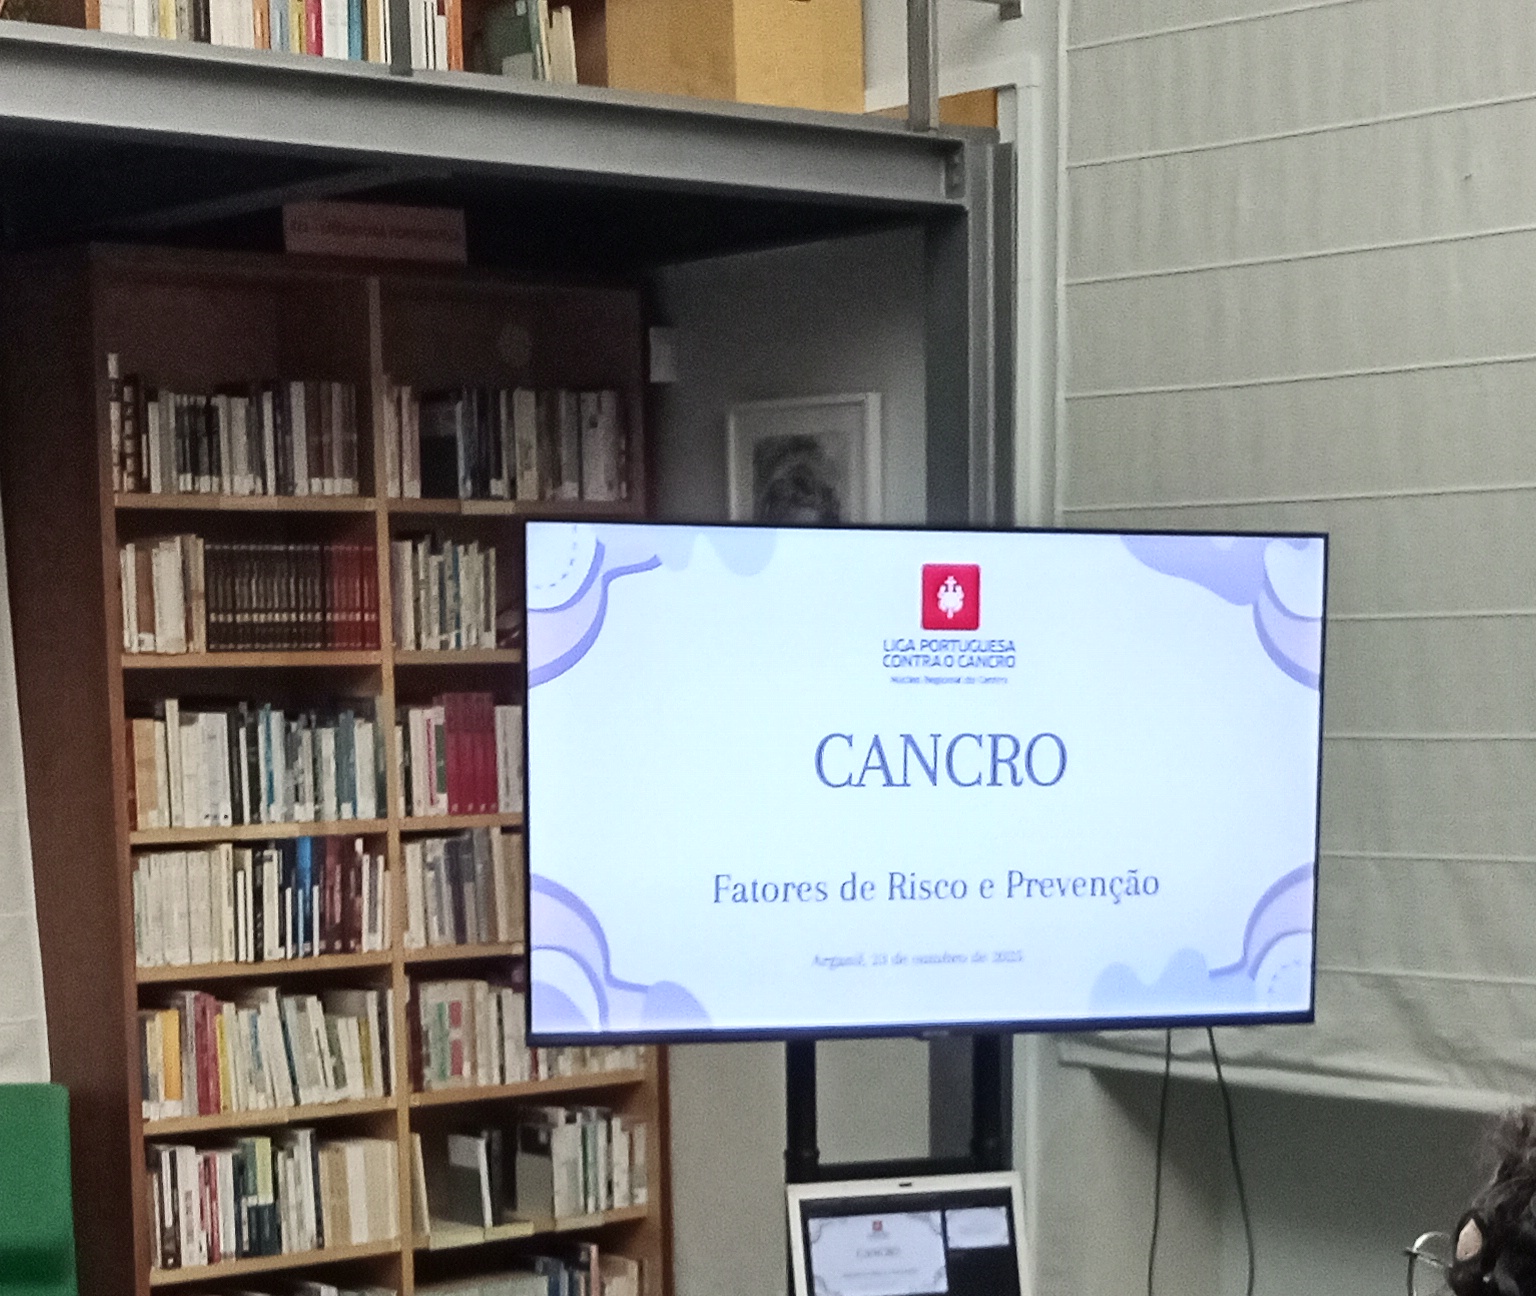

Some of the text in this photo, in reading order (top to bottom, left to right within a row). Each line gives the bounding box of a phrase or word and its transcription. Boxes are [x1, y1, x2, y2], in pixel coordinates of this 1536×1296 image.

[882, 638, 1016, 653] LIGA PORTUGUESA
[882, 654, 1016, 668] CONTRA O CANCRO
[814, 732, 1068, 788] CANCRO
[713, 868, 1161, 905] Fatores de Risco e Prevenção
